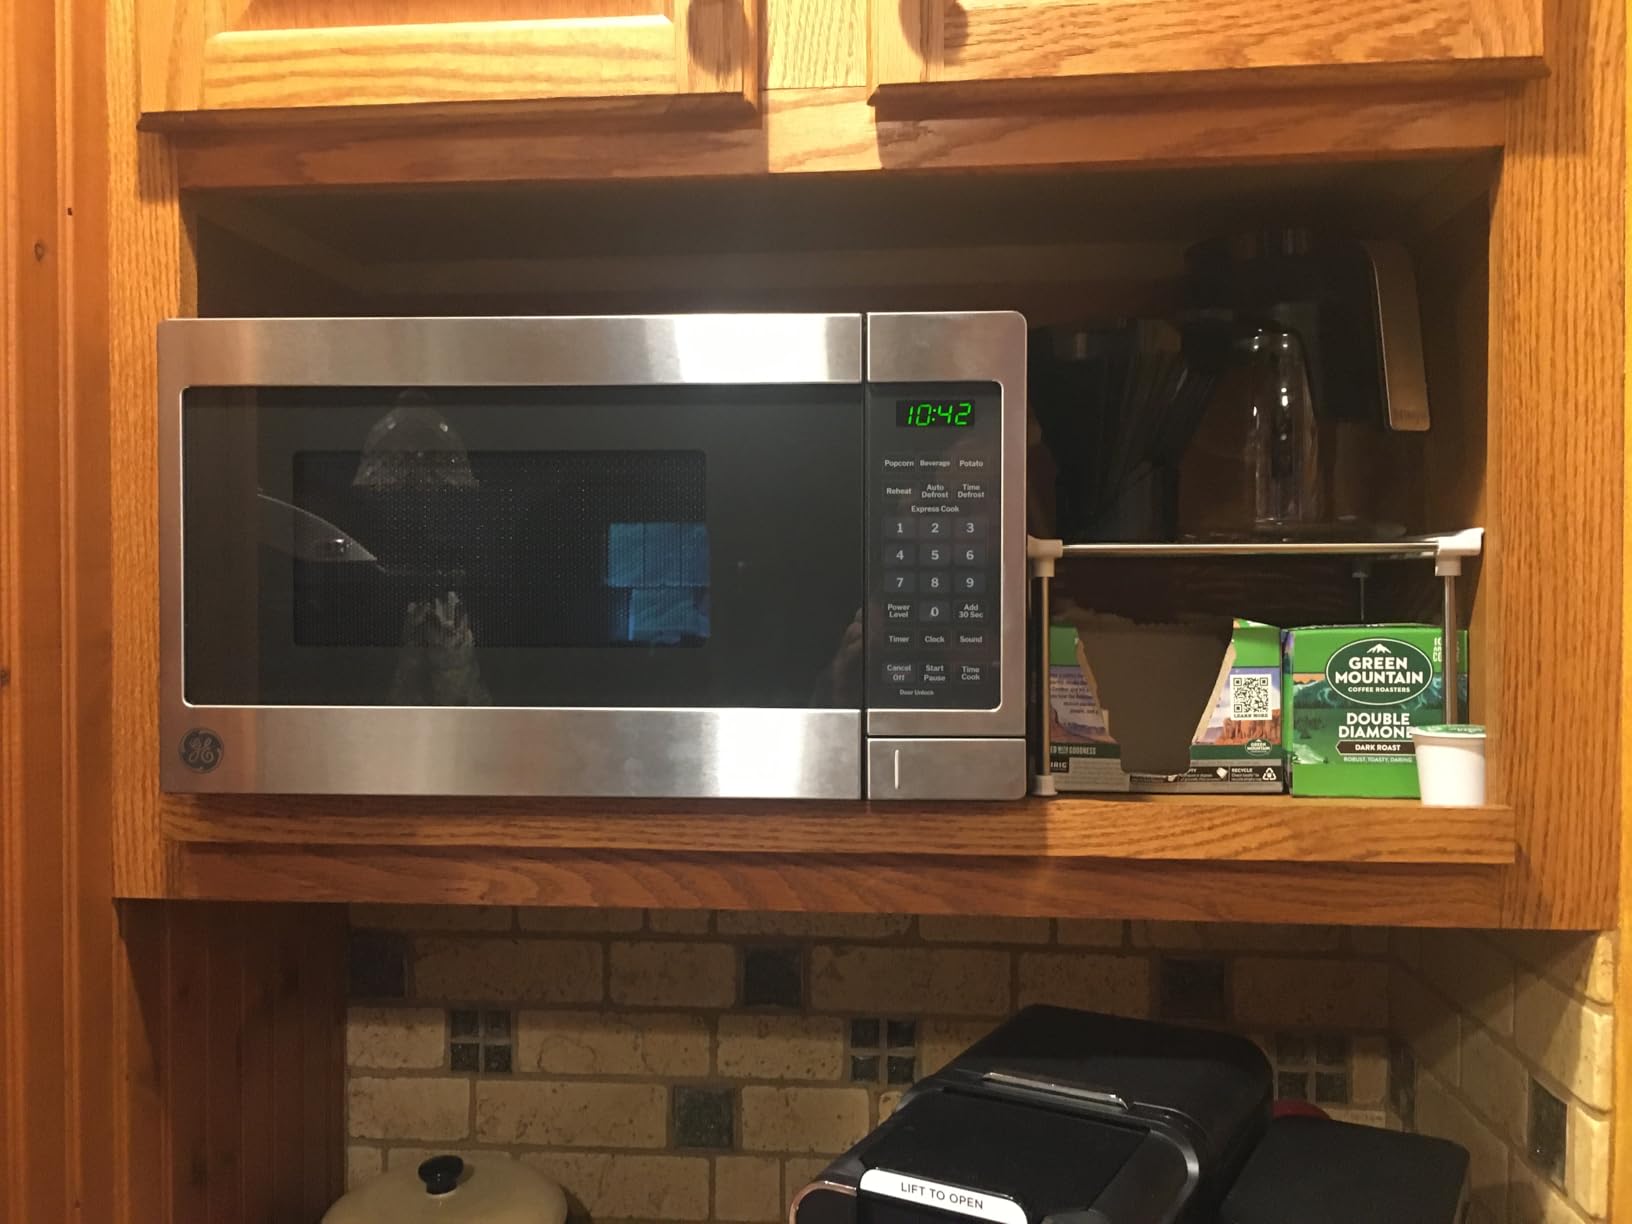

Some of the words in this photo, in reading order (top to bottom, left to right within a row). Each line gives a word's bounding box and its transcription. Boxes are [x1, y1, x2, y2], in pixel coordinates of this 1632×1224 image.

[908, 403, 971, 426] 10:42
[885, 460, 914, 468] Popcorn
[911, 505, 939, 513] Express
[897, 523, 903, 533] 1
[931, 523, 939, 533] 2
[966, 523, 974, 533] 3
[896, 550, 904, 560] 4
[931, 550, 939, 560] 5
[966, 550, 974, 560] 6
[896, 578, 904, 588] 7
[931, 578, 939, 588] 8
[966, 578, 974, 588] 9
[931, 607, 939, 617] 0
[889, 635, 909, 643] Timer
[925, 635, 944, 643] Clock
[960, 635, 983, 643] Sound
[887, 664, 911, 672] Cancel
[926, 664, 944, 672] Start
[1349, 657, 1408, 670] GREEN
[893, 673, 905, 681] Off
[1335, 671, 1424, 684] MOUNTAIN
[1346, 712, 1410, 725] DOUBLE
[901, 1182, 926, 1197] LIFT
[930, 1188, 946, 1201] TO
[949, 1193, 984, 1210] OPEN
